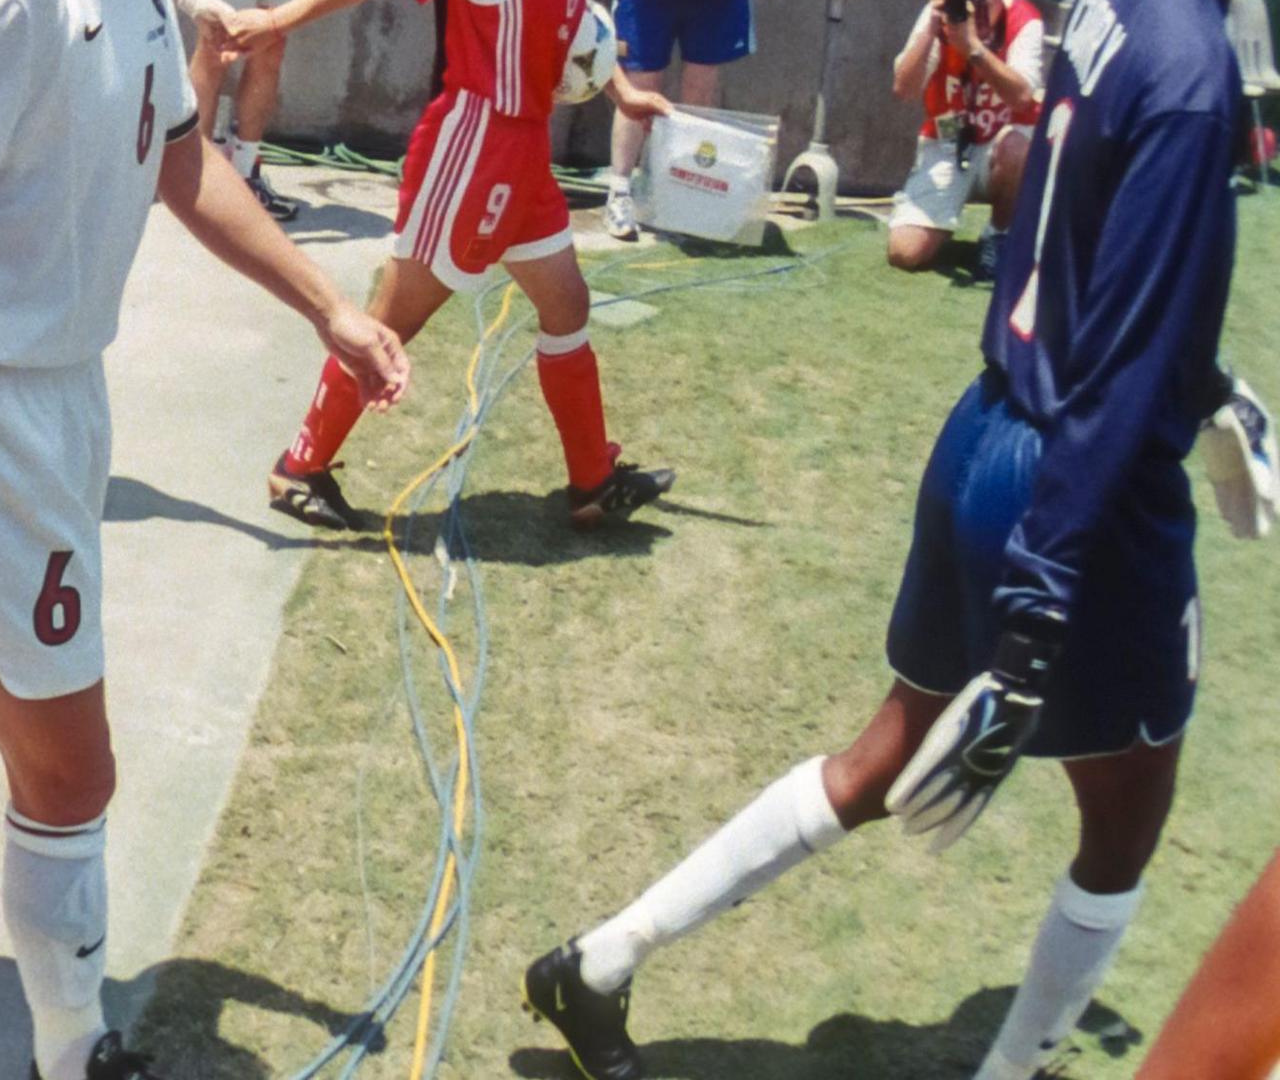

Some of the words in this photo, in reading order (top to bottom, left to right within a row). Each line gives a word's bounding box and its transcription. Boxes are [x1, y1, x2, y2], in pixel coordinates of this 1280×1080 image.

[136, 63, 155, 165] 6
[477, 183, 512, 236] 9
[1009, 96, 1075, 342] 1
[33, 550, 81, 647] 6
[1180, 597, 1200, 682] 1
